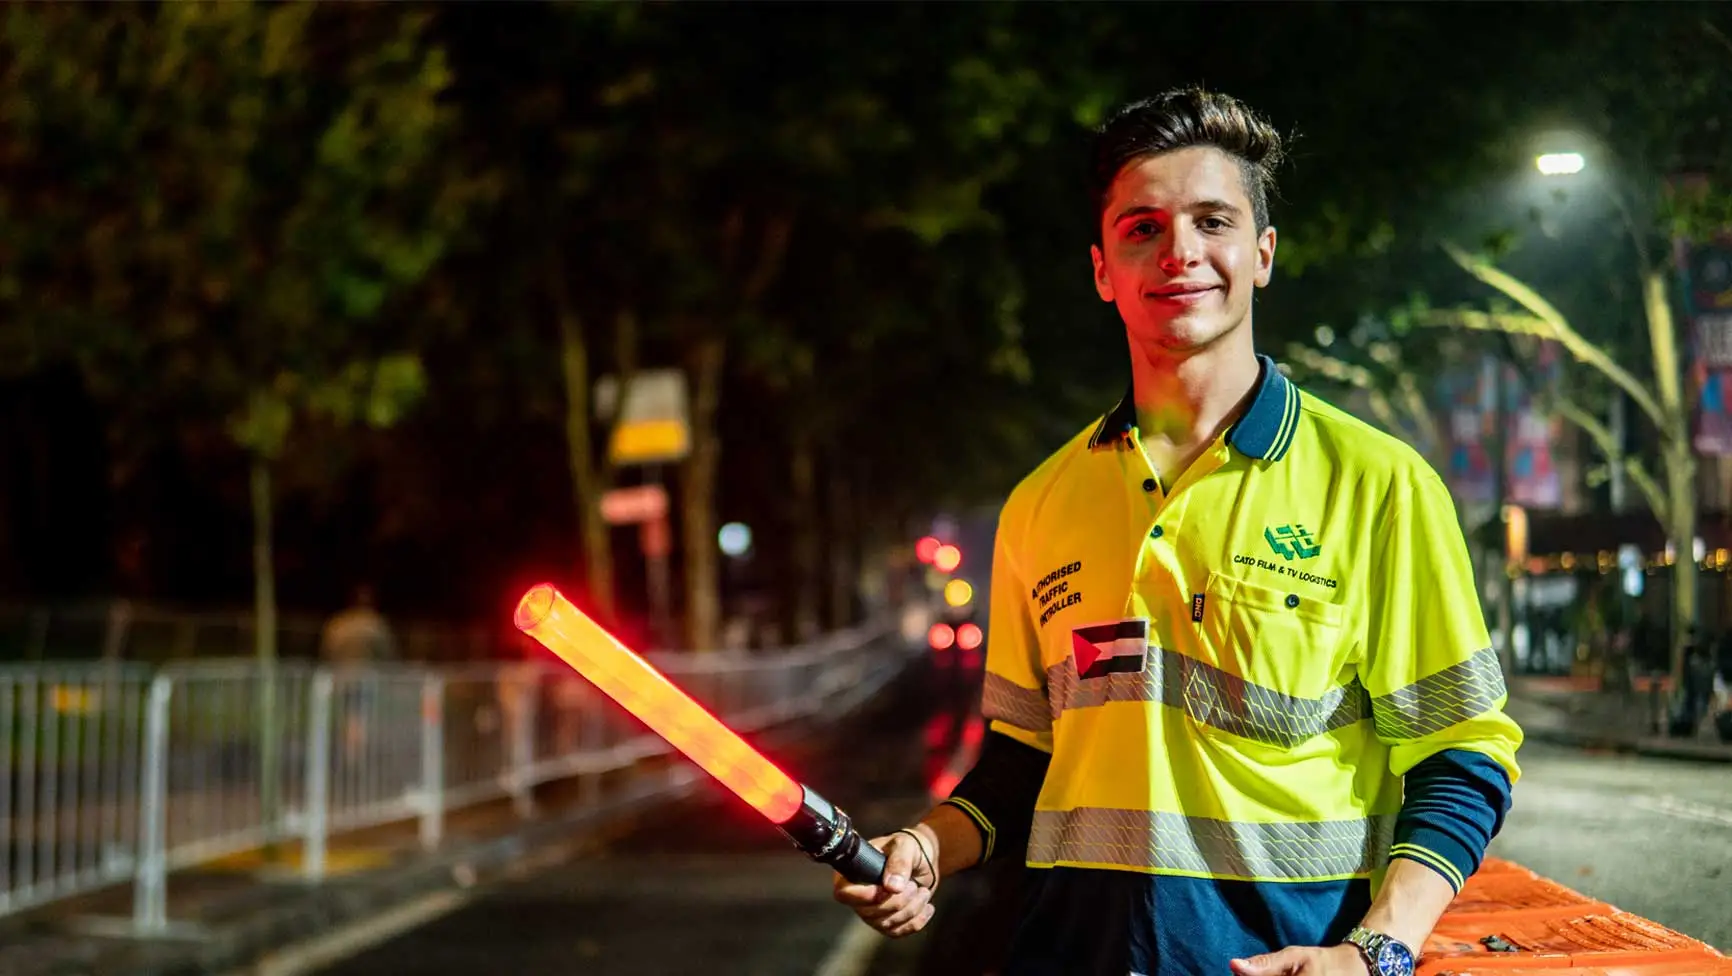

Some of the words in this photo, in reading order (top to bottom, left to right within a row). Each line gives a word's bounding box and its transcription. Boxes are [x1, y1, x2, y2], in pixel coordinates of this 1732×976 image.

[1233, 555, 1255, 566] CATO
[1257, 559, 1276, 571] FILM
[1287, 567, 1298, 577] TV
[1299, 571, 1336, 588] LOGISTICS
